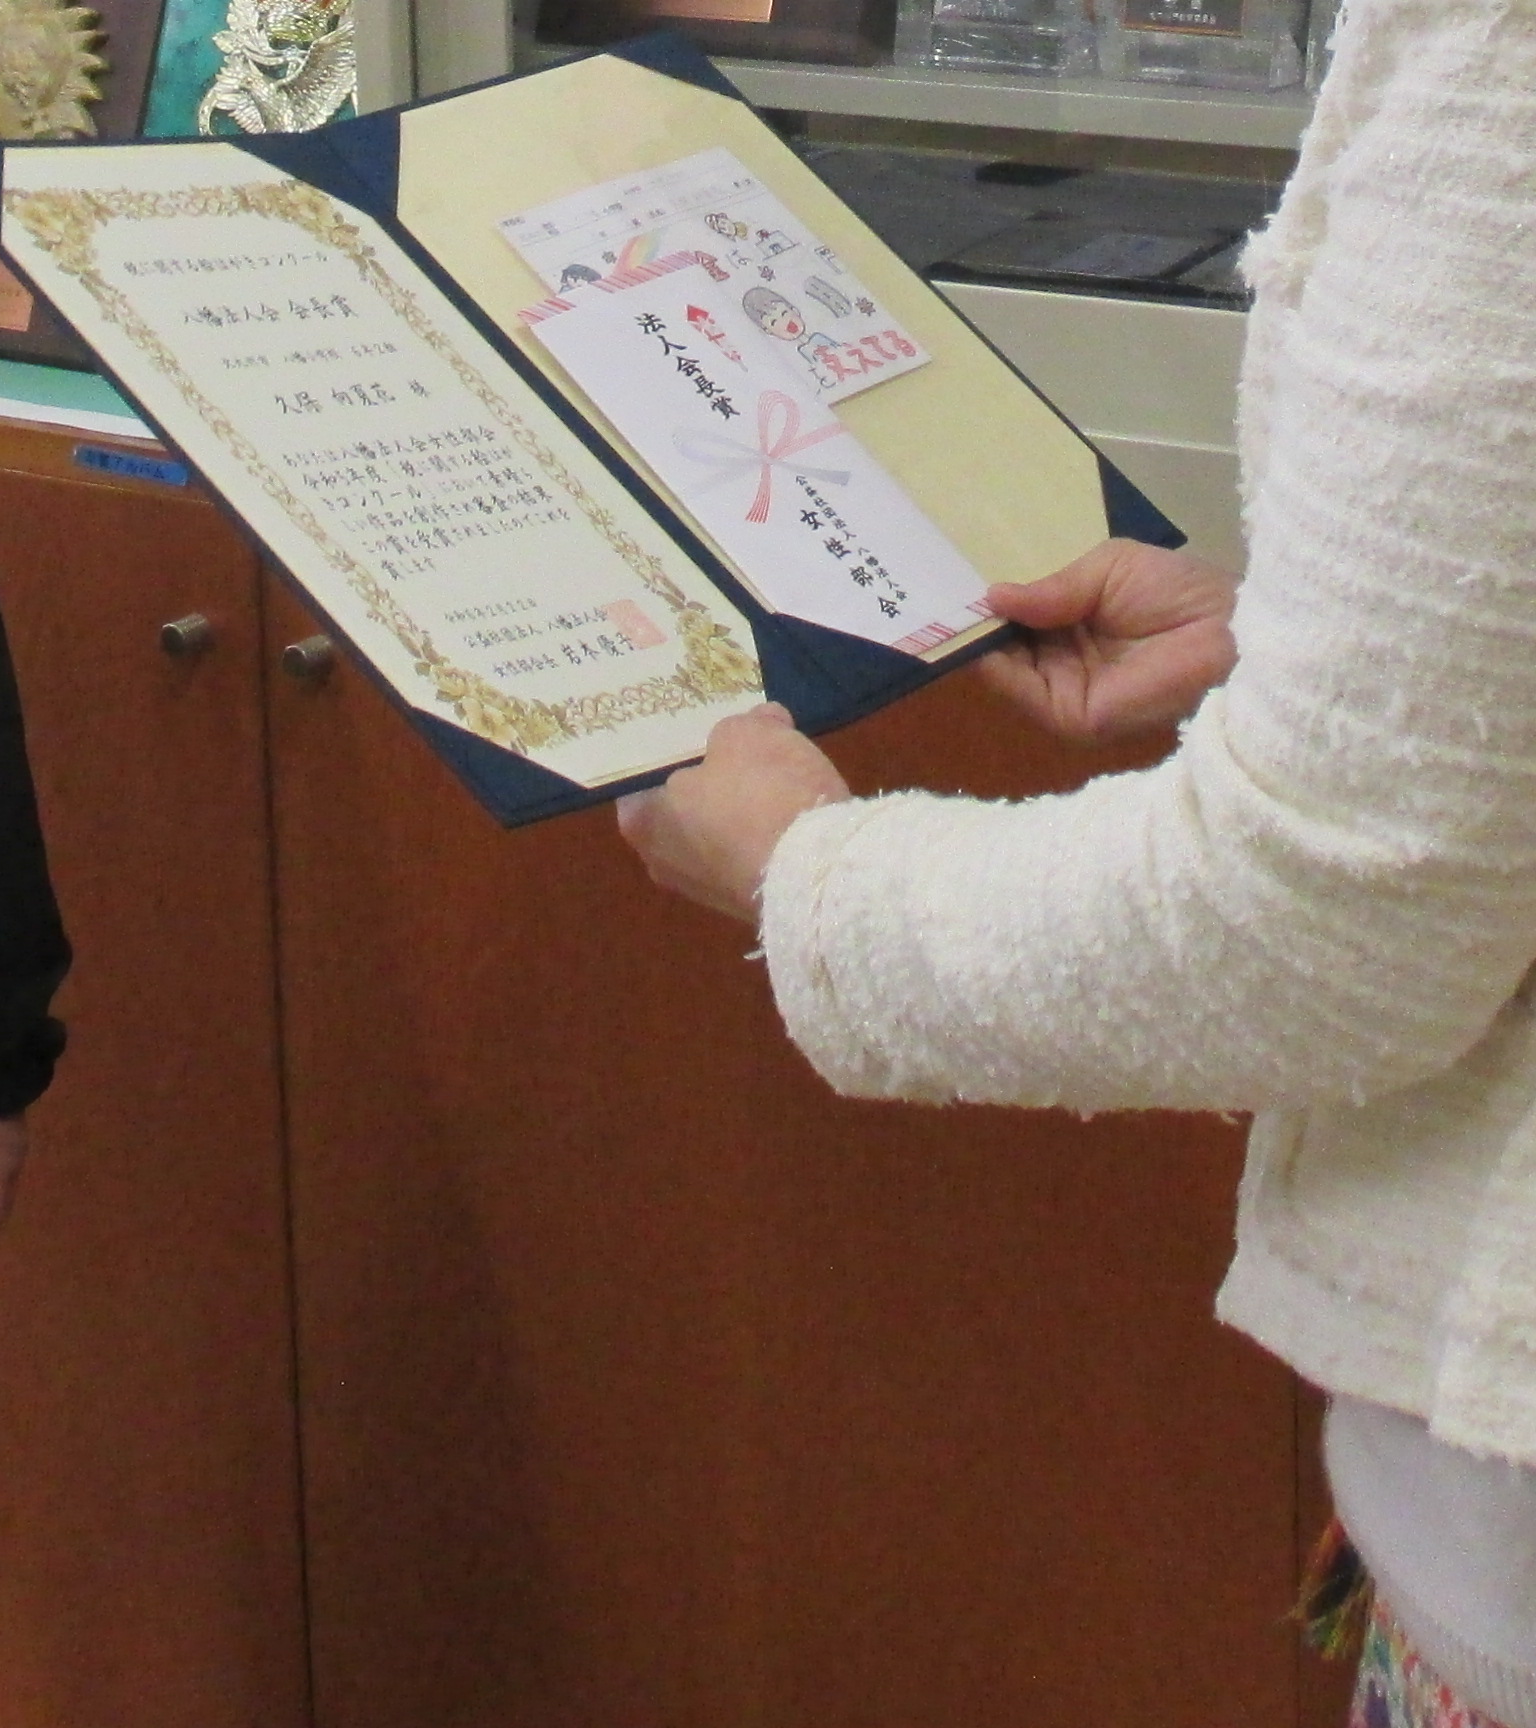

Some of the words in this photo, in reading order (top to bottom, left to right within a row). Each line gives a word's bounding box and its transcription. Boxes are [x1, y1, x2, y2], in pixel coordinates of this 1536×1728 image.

[633, 311, 742, 422] 法人会長賞
[799, 509, 902, 619] 女性部会
